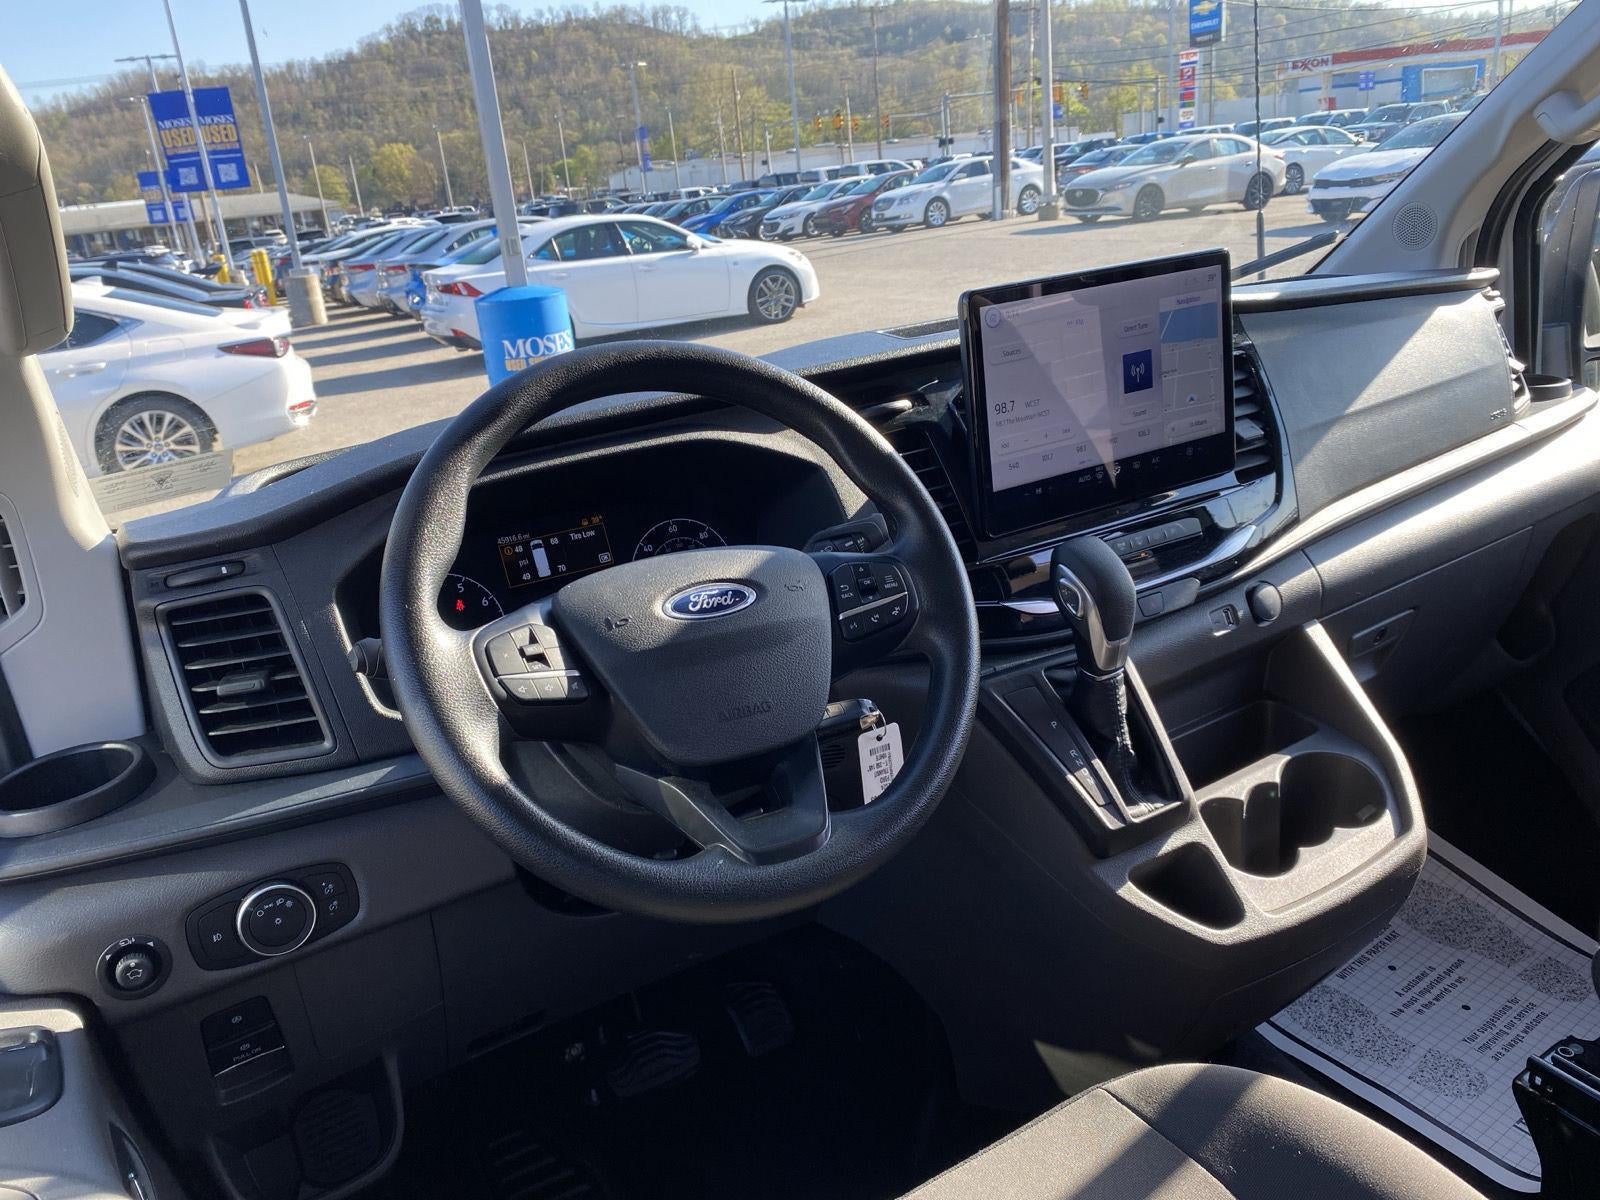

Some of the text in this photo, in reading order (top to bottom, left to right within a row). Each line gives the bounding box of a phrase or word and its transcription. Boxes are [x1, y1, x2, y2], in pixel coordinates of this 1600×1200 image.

[1191, 18, 1219, 29] CHEVROLET
[1291, 57, 1330, 72] EXXON
[157, 116, 193, 128] MOSES
[199, 114, 235, 124] MOSES
[161, 126, 195, 148] USED
[201, 124, 238, 144] USED
[502, 329, 571, 359] MOSES
[994, 400, 1015, 415] 98.7
[668, 524, 678, 533] 60
[569, 529, 596, 541] Tire Low
[643, 544, 653, 552] 40
[519, 558, 529, 568] psi
[456, 583, 465, 593] 5
[482, 596, 489, 607] 6
[688, 589, 741, 611] Ford
[1050, 721, 1057, 729] P
[1069, 750, 1077, 758] R
[1335, 929, 1401, 980] WITH THIS PAPER MAT
[1394, 965, 1437, 998] A customer is
[1446, 982, 1458, 990] to
[1389, 958, 1465, 1018] the most important person
[1432, 986, 1453, 1002] world
[1420, 1000, 1436, 1010] the
[1415, 1008, 1426, 1016] in
[1462, 996, 1521, 1045] Your suggestions for
[1475, 1001, 1537, 1055] improving our service
[1491, 1050, 1505, 1062] are
[1501, 1033, 1525, 1053] always
